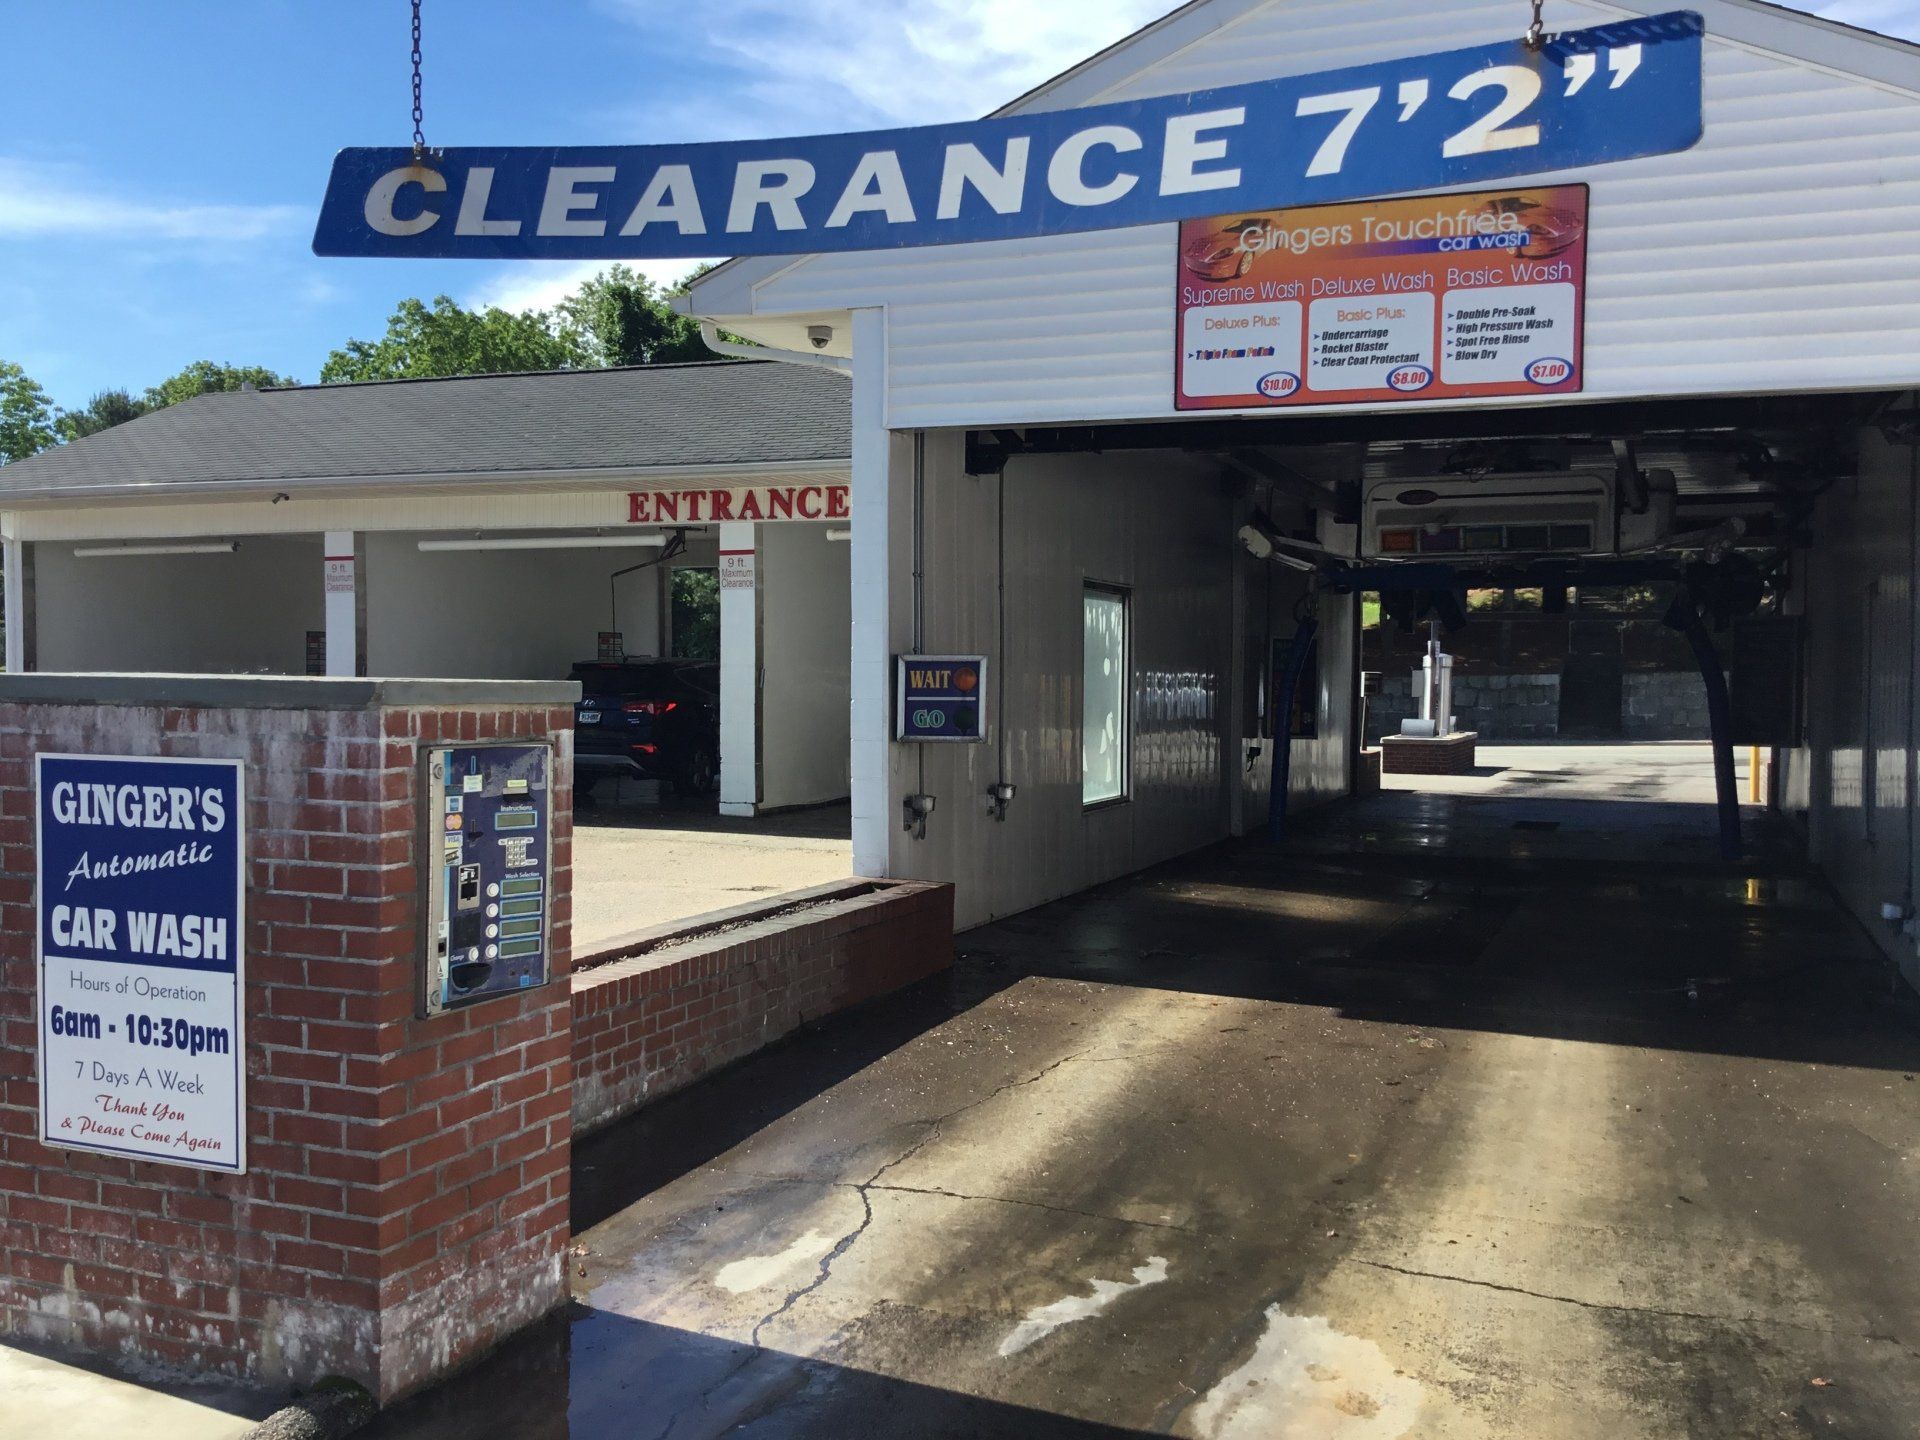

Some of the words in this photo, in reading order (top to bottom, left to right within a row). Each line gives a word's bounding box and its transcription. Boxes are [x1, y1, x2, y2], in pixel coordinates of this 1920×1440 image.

[364, 107, 1245, 237] CLEARANCE
[1239, 221, 1352, 255] Gingers
[1361, 209, 1518, 243] Touchfree
[1438, 236, 1474, 251] car
[1477, 231, 1530, 248] wash
[1311, 276, 1376, 296] Deluxe
[1382, 270, 1434, 291] Wash
[1447, 266, 1504, 287] Basic
[1511, 261, 1572, 282] Wash
[1183, 285, 1255, 307] Supreme
[1260, 280, 1305, 299] Wash
[1337, 309, 1373, 322] Basic
[1376, 307, 1406, 320] Plus:
[1456, 308, 1491, 320] Double
[1492, 306, 1537, 318] Pre-Soak
[1204, 318, 1249, 331] Deluxe
[1253, 315, 1281, 328] Plus:
[1456, 322, 1478, 334] High
[1479, 320, 1524, 332] Pressure
[1525, 318, 1554, 329] Wash
[1321, 328, 1389, 341] Undercarriage
[1455, 336, 1478, 348] Spot
[1479, 335, 1501, 346] Free
[1502, 333, 1530, 344] Rinse
[1321, 343, 1354, 354] Rocket
[1354, 341, 1389, 353] Blaster
[1455, 350, 1479, 361] Blow
[1480, 349, 1498, 361] Dry
[1321, 357, 1349, 367] Clear
[1349, 356, 1370, 366] Coat
[1370, 353, 1420, 365] Protectant
[1392, 371, 1427, 385] $8.00
[1532, 364, 1566, 378] $7.00
[1263, 378, 1294, 391] $10.00
[627, 485, 851, 523] ENTRANCE
[727, 557, 735, 568] 9
[721, 568, 753, 578] Maximum
[721, 578, 754, 588] Clearance
[909, 670, 952, 689] WAIT
[912, 709, 946, 729] GO
[52, 781, 226, 833] GINGER'S
[500, 804, 533, 812] Instructions
[64, 841, 213, 892] Automatic
[51, 904, 117, 951] CAR
[126, 910, 228, 961] WASH
[70, 969, 110, 992] Hours
[115, 976, 129, 994] of
[134, 976, 206, 1002] Operation
[51, 1004, 101, 1040] 6am
[125, 1013, 229, 1057] 10:30pm
[74, 1060, 84, 1079] 7
[93, 1061, 130, 1088] Days
[135, 1067, 153, 1089] A
[157, 1069, 204, 1095] Week
[95, 1094, 148, 1117] Thank
[152, 1102, 185, 1122] You
[60, 1116, 73, 1129] &
[77, 1115, 125, 1137] Please
[130, 1124, 171, 1144] Come
[173, 1130, 222, 1152] Again
